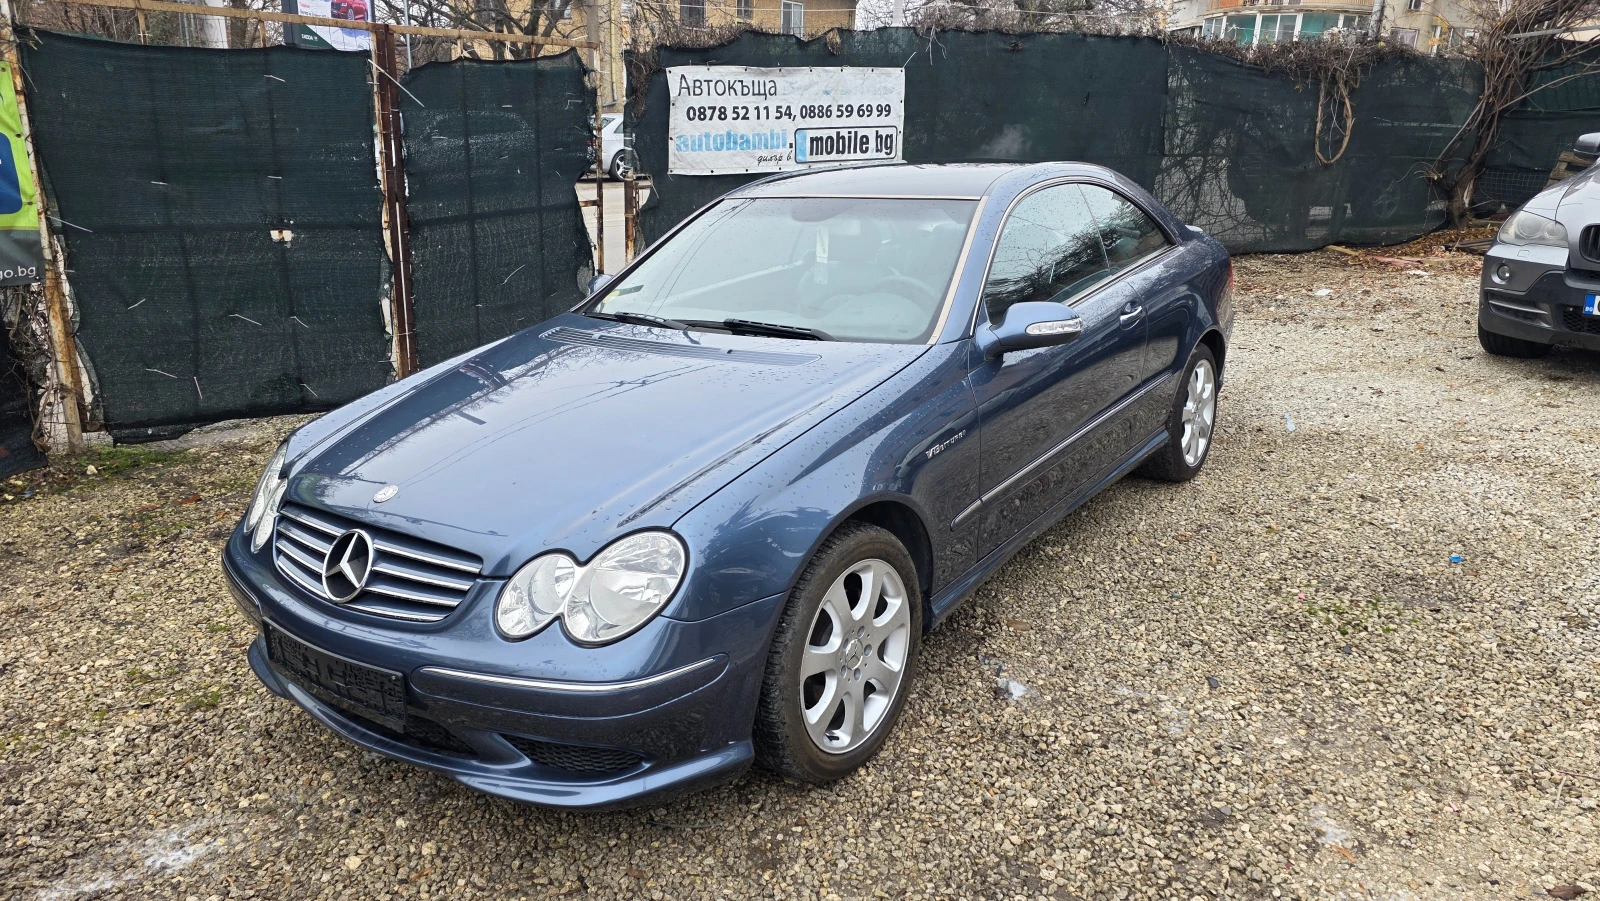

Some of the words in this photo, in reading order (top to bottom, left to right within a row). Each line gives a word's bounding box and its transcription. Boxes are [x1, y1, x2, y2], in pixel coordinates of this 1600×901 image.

[678, 74, 778, 100] Автокъща
[686, 105, 728, 121] 0878
[731, 105, 750, 120] 52
[754, 104, 771, 120] 11
[774, 104, 797, 122] 54,
[799, 103, 832, 119] 0886
[836, 103, 854, 119] 59
[856, 103, 873, 119] 69
[876, 103, 892, 118] 99
